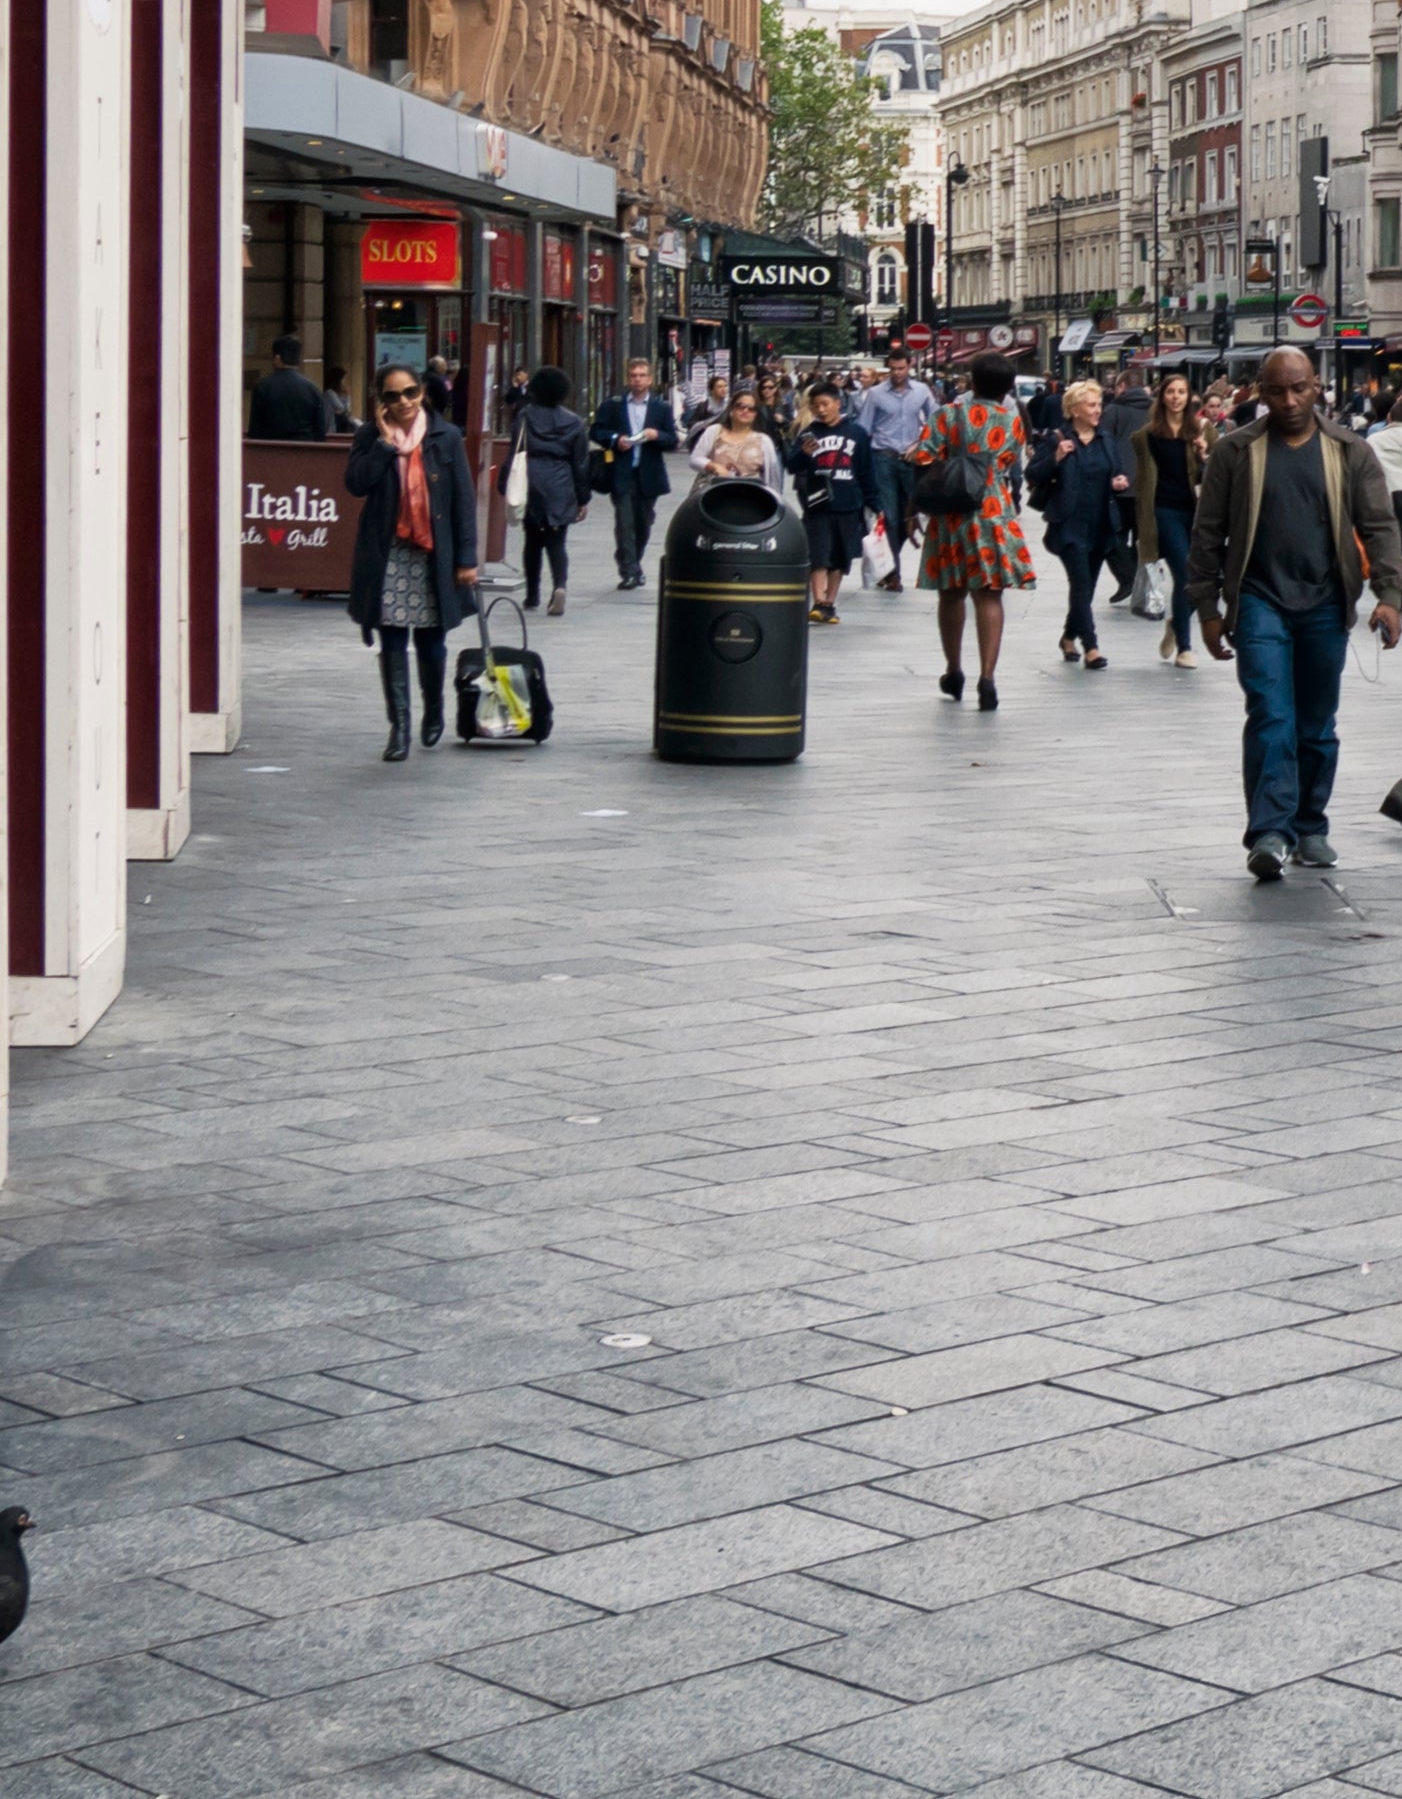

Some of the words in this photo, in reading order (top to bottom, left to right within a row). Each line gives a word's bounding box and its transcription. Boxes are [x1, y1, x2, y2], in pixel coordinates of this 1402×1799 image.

[368, 238, 437, 264] SLOTS
[731, 264, 831, 286] CASINO
[690, 284, 730, 297] HALF
[690, 297, 730, 309] PRICE
[244, 482, 339, 522] Italia
[240, 525, 265, 545] sta
